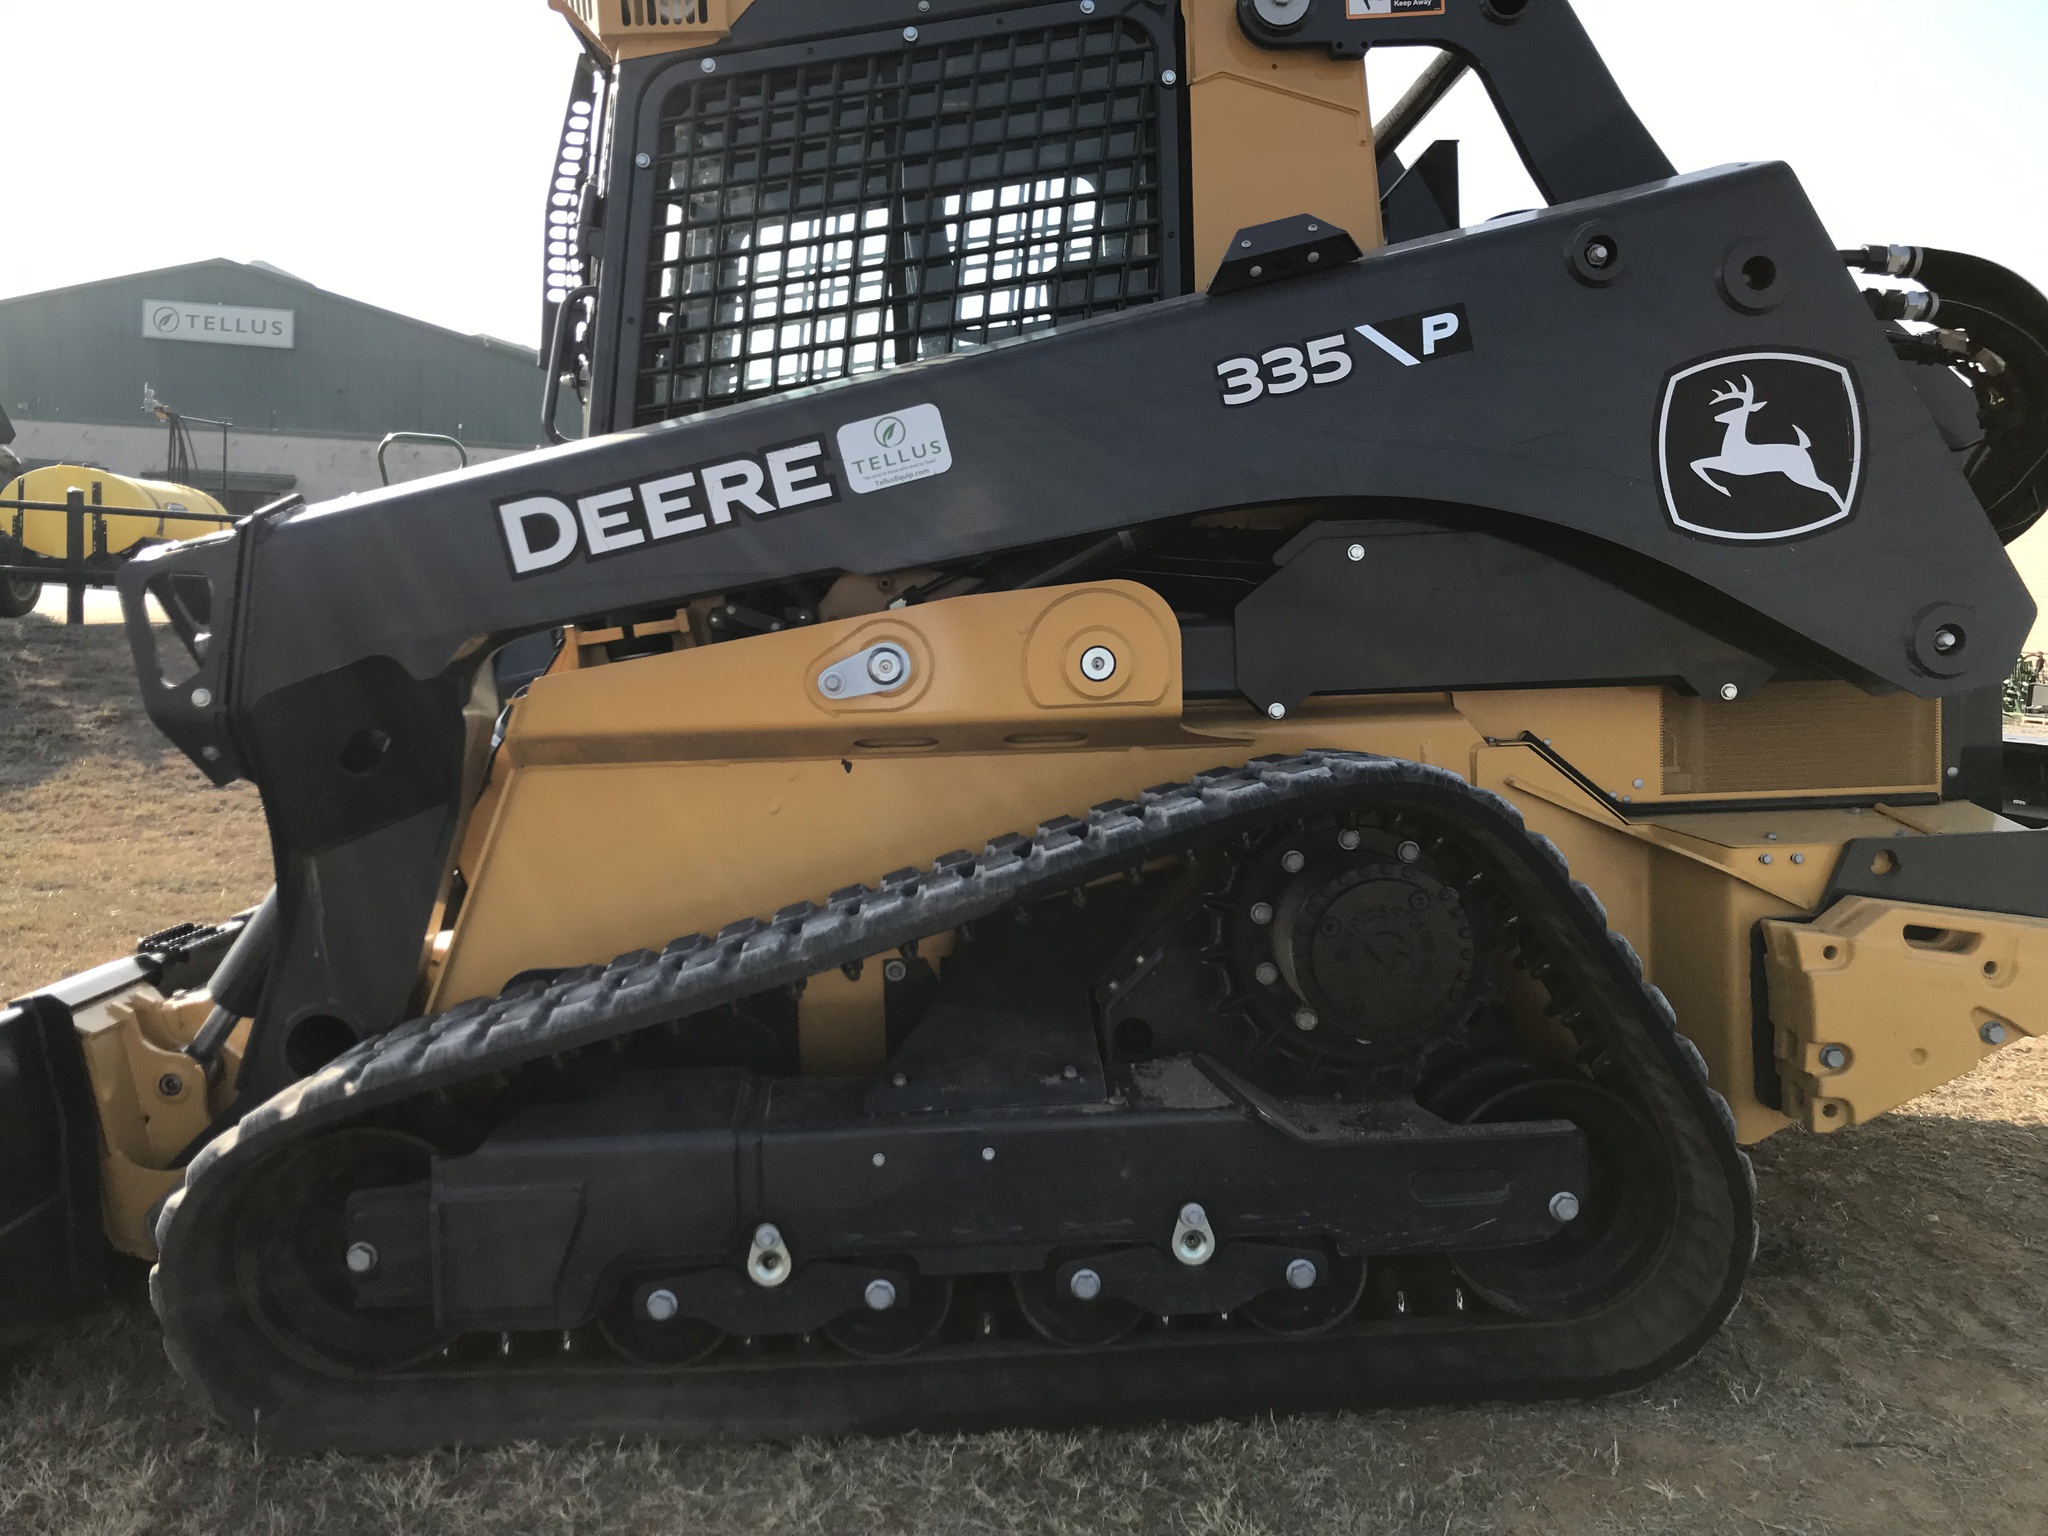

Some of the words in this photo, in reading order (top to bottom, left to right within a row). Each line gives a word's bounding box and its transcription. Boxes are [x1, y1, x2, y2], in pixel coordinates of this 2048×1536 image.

[185, 314, 283, 336] TELLUS
[1216, 333, 1353, 405] 335
[851, 440, 942, 474] TELLUS
[874, 468, 930, 487] TellusEquip.com
[499, 440, 833, 574] DEERE
